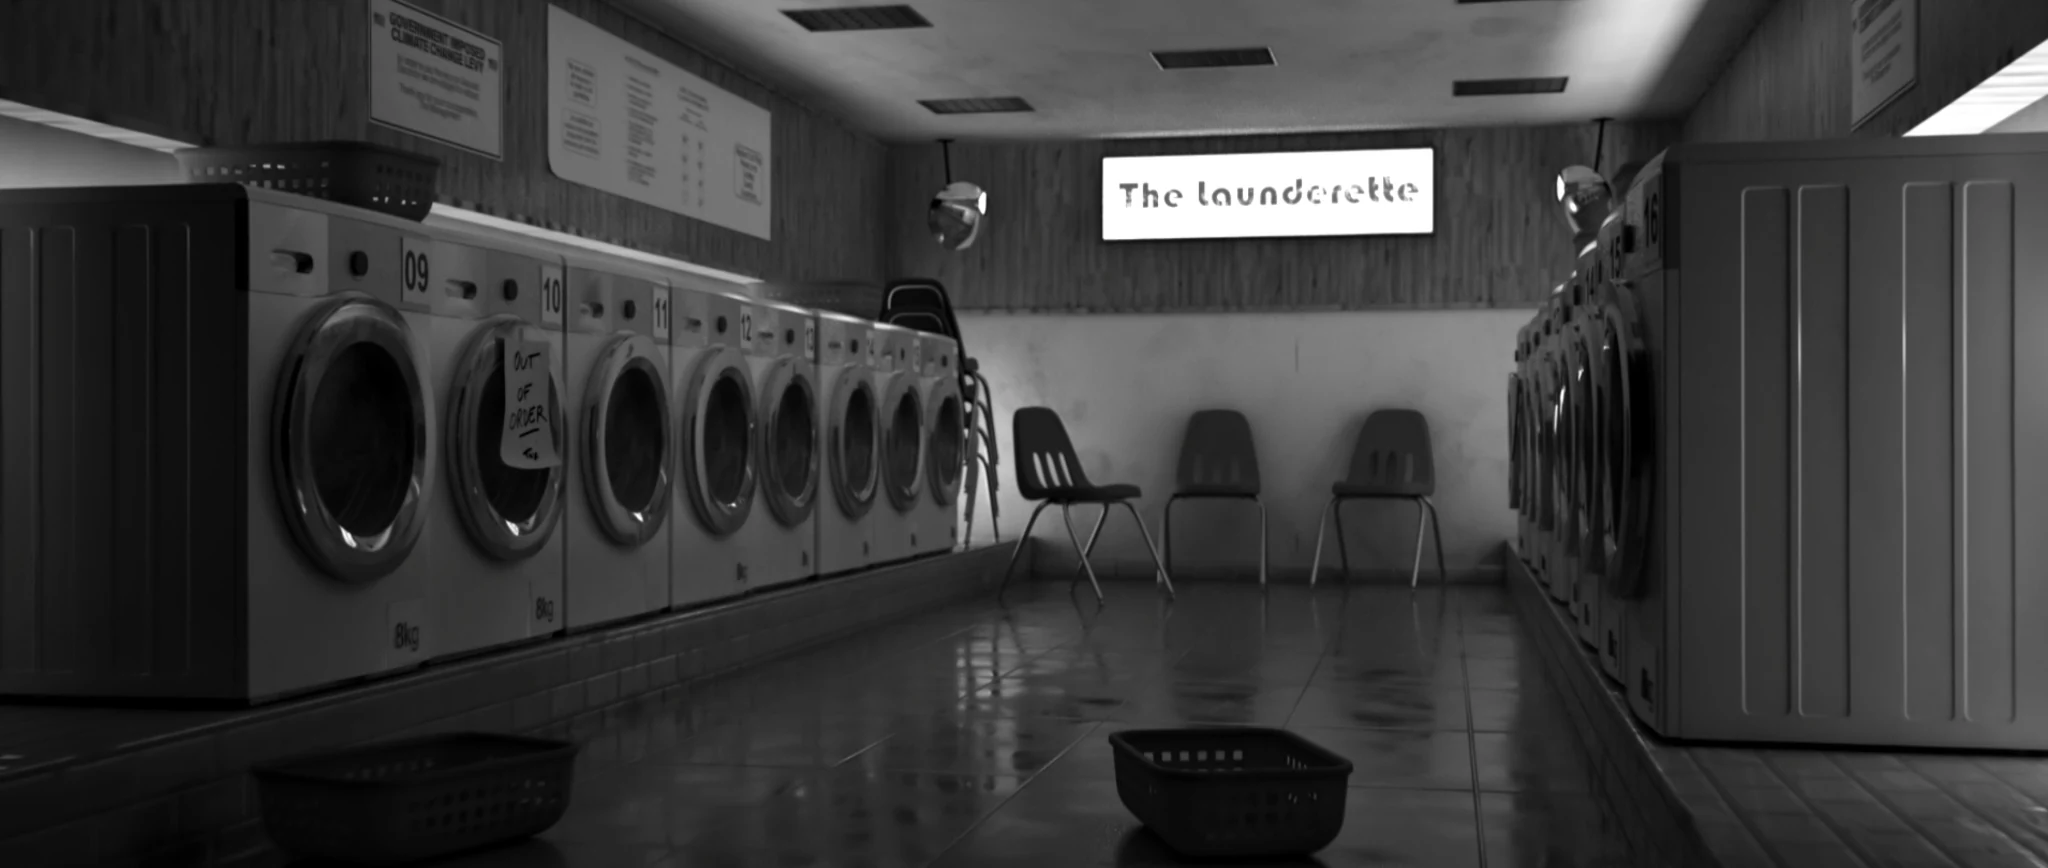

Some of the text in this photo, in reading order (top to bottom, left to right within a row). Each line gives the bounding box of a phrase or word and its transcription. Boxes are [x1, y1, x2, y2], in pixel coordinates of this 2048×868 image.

[390, 11, 449, 45] GOVERNMENT
[451, 37, 486, 60] IMPOSED
[391, 28, 430, 52] CLIMATE
[430, 43, 464, 66] CHANGE
[465, 57, 485, 73] LEVY
[1119, 182, 1183, 208] The
[1644, 193, 1658, 248] 16
[405, 250, 429, 294] 09
[1610, 235, 1621, 279] 15
[543, 277, 561, 314] 10
[654, 297, 667, 329] 11
[740, 313, 752, 342] 12
[514, 350, 541, 372] OUT
[517, 382, 533, 402] OF
[509, 404, 548, 430] ORDER
[535, 596, 554, 624] 8kg
[394, 621, 420, 653] 8kg
